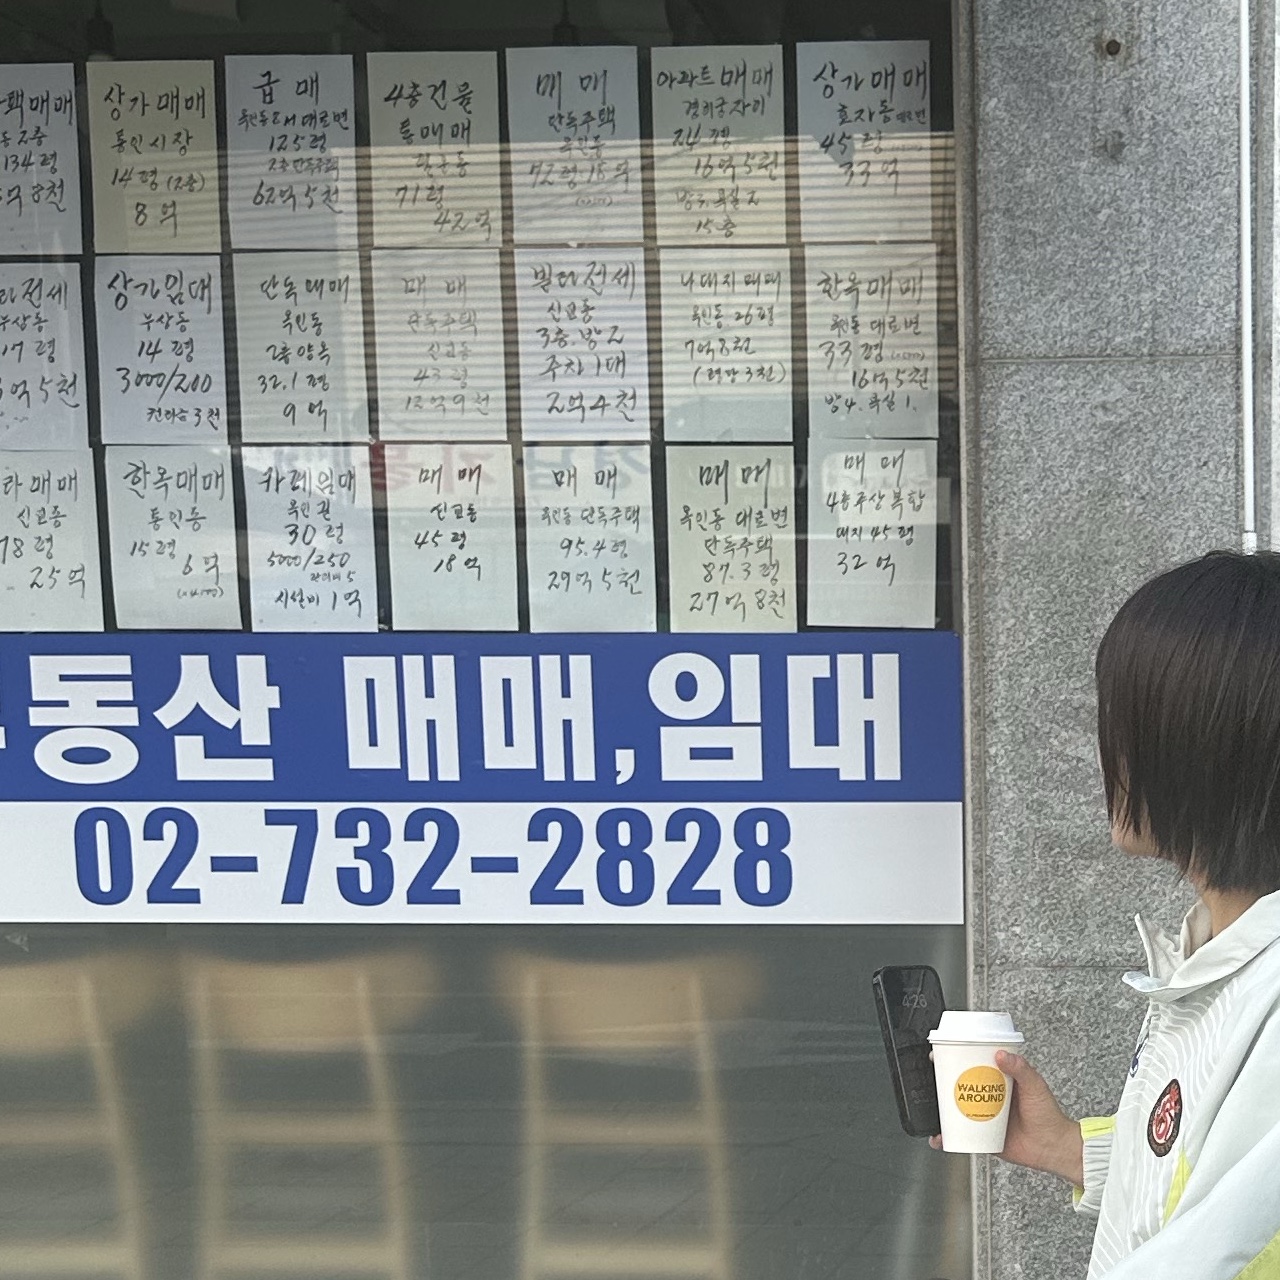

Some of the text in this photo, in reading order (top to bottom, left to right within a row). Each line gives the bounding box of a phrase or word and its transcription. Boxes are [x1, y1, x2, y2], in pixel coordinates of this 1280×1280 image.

[0, 87, 74, 127] 택매매
[0, 652, 281, 785] 동산
[74, 806, 795, 908] 02-732-2828
[957, 1083, 1005, 1094] WALKING
[957, 1093, 1004, 1103] AROUND
